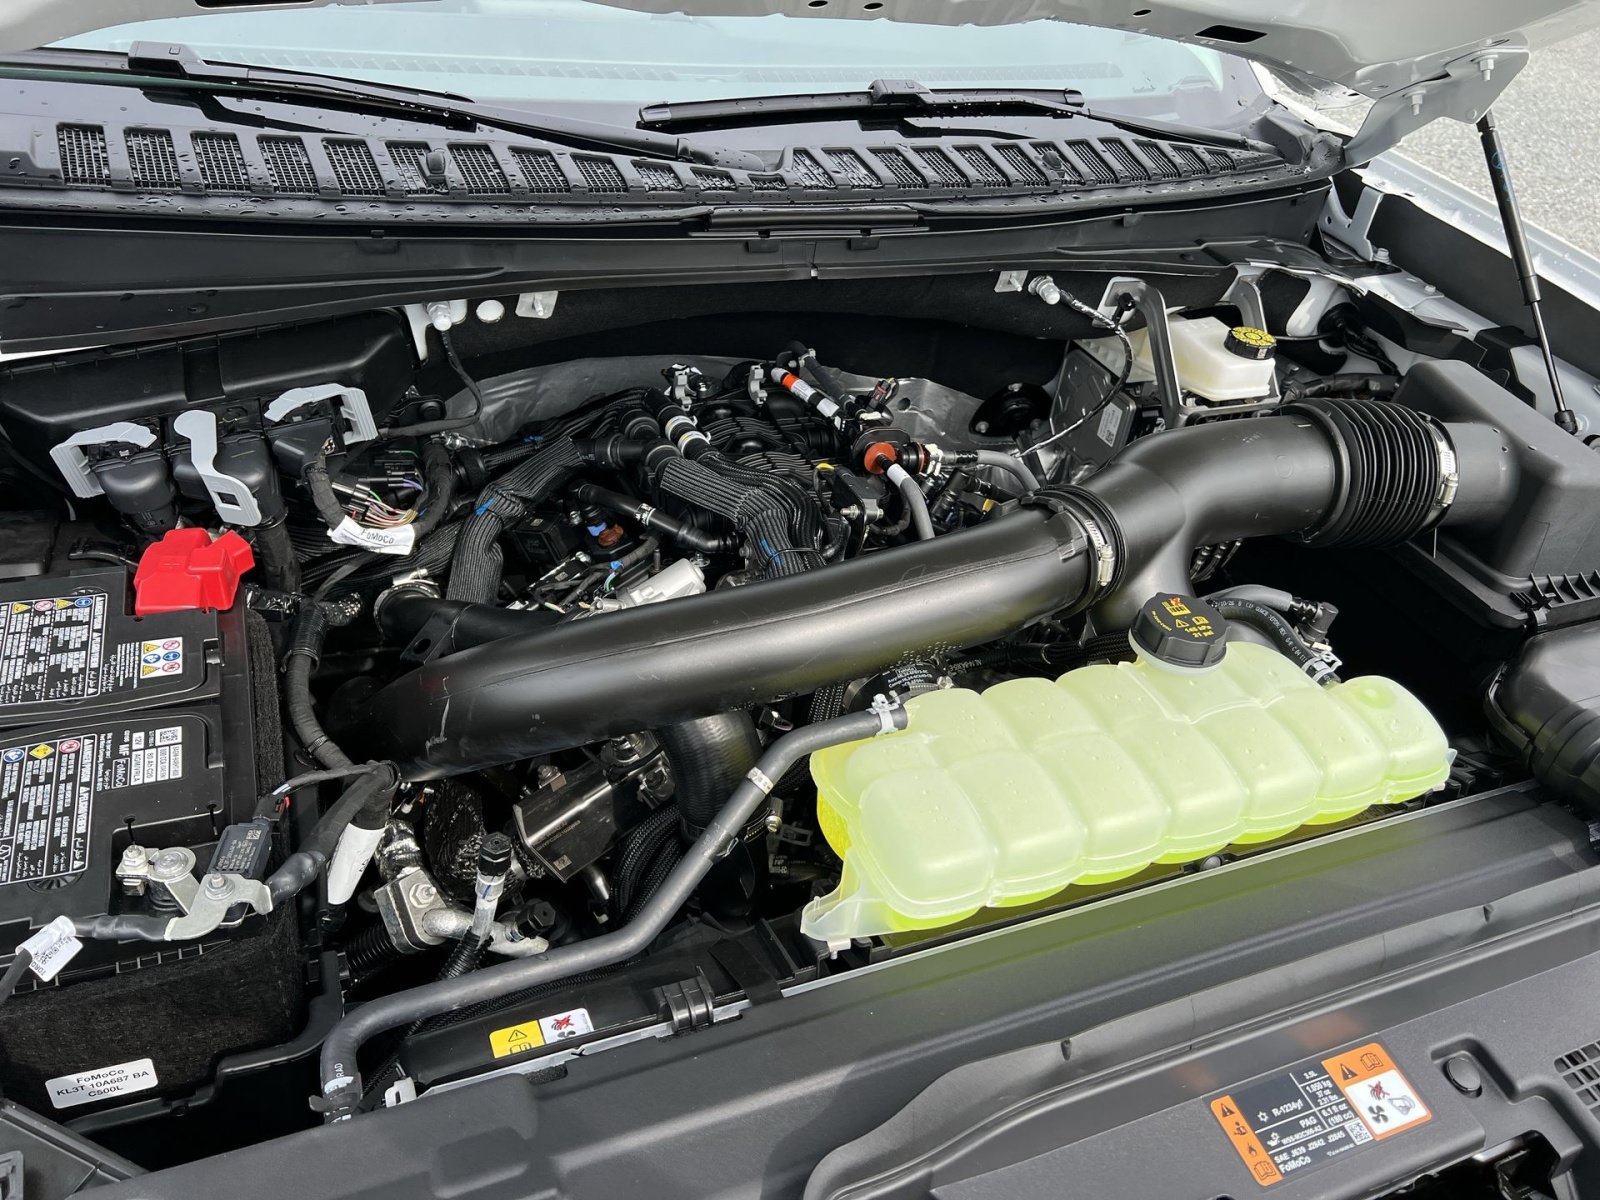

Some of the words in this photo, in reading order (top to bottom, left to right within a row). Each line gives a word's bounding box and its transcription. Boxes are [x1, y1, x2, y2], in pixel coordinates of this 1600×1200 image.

[361, 528, 395, 544] FoMoCo
[134, 735, 142, 745] 12V
[119, 744, 130, 756] MF
[115, 759, 126, 787] FoMoCo
[146, 768, 154, 779] C20
[334, 1062, 345, 1078] RAD
[76, 1069, 125, 1084] FoMoCo
[56, 1084, 86, 1096] KL3T
[89, 1075, 129, 1089] 10A687
[132, 1070, 150, 1080] BA
[1322, 1080, 1333, 1088] kg
[88, 1085, 124, 1097] C500L
[1271, 1098, 1304, 1117] R-1234yf
[1338, 1103, 1349, 1111] oz
[1342, 1110, 1356, 1119] cc)
[1299, 1116, 1317, 1128] PAG
[1274, 1152, 1291, 1164] SAE
[1278, 1155, 1312, 1173] FoMoCo
